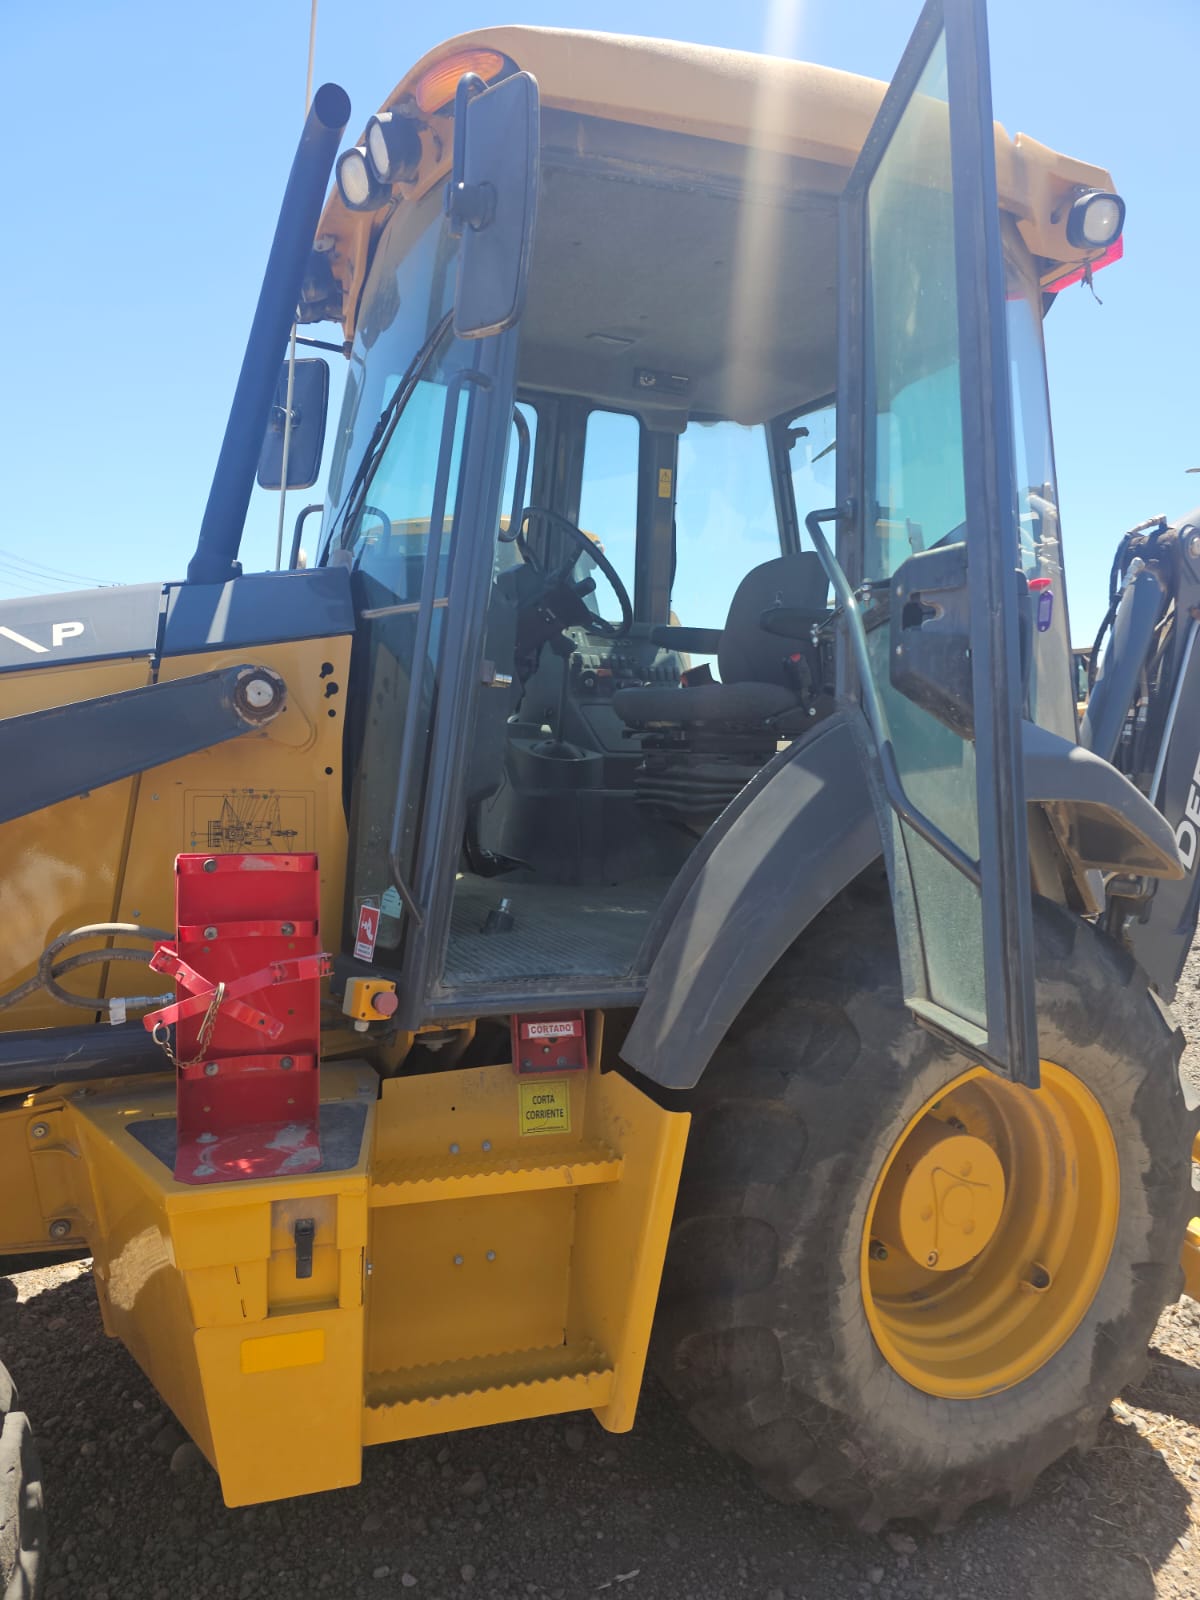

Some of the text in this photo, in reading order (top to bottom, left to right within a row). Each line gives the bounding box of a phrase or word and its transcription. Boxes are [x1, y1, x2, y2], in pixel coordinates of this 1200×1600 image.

[530, 1023, 572, 1035] CORTADO
[532, 1094, 555, 1105] CORTA
[525, 1108, 564, 1120] CORRIENTE
